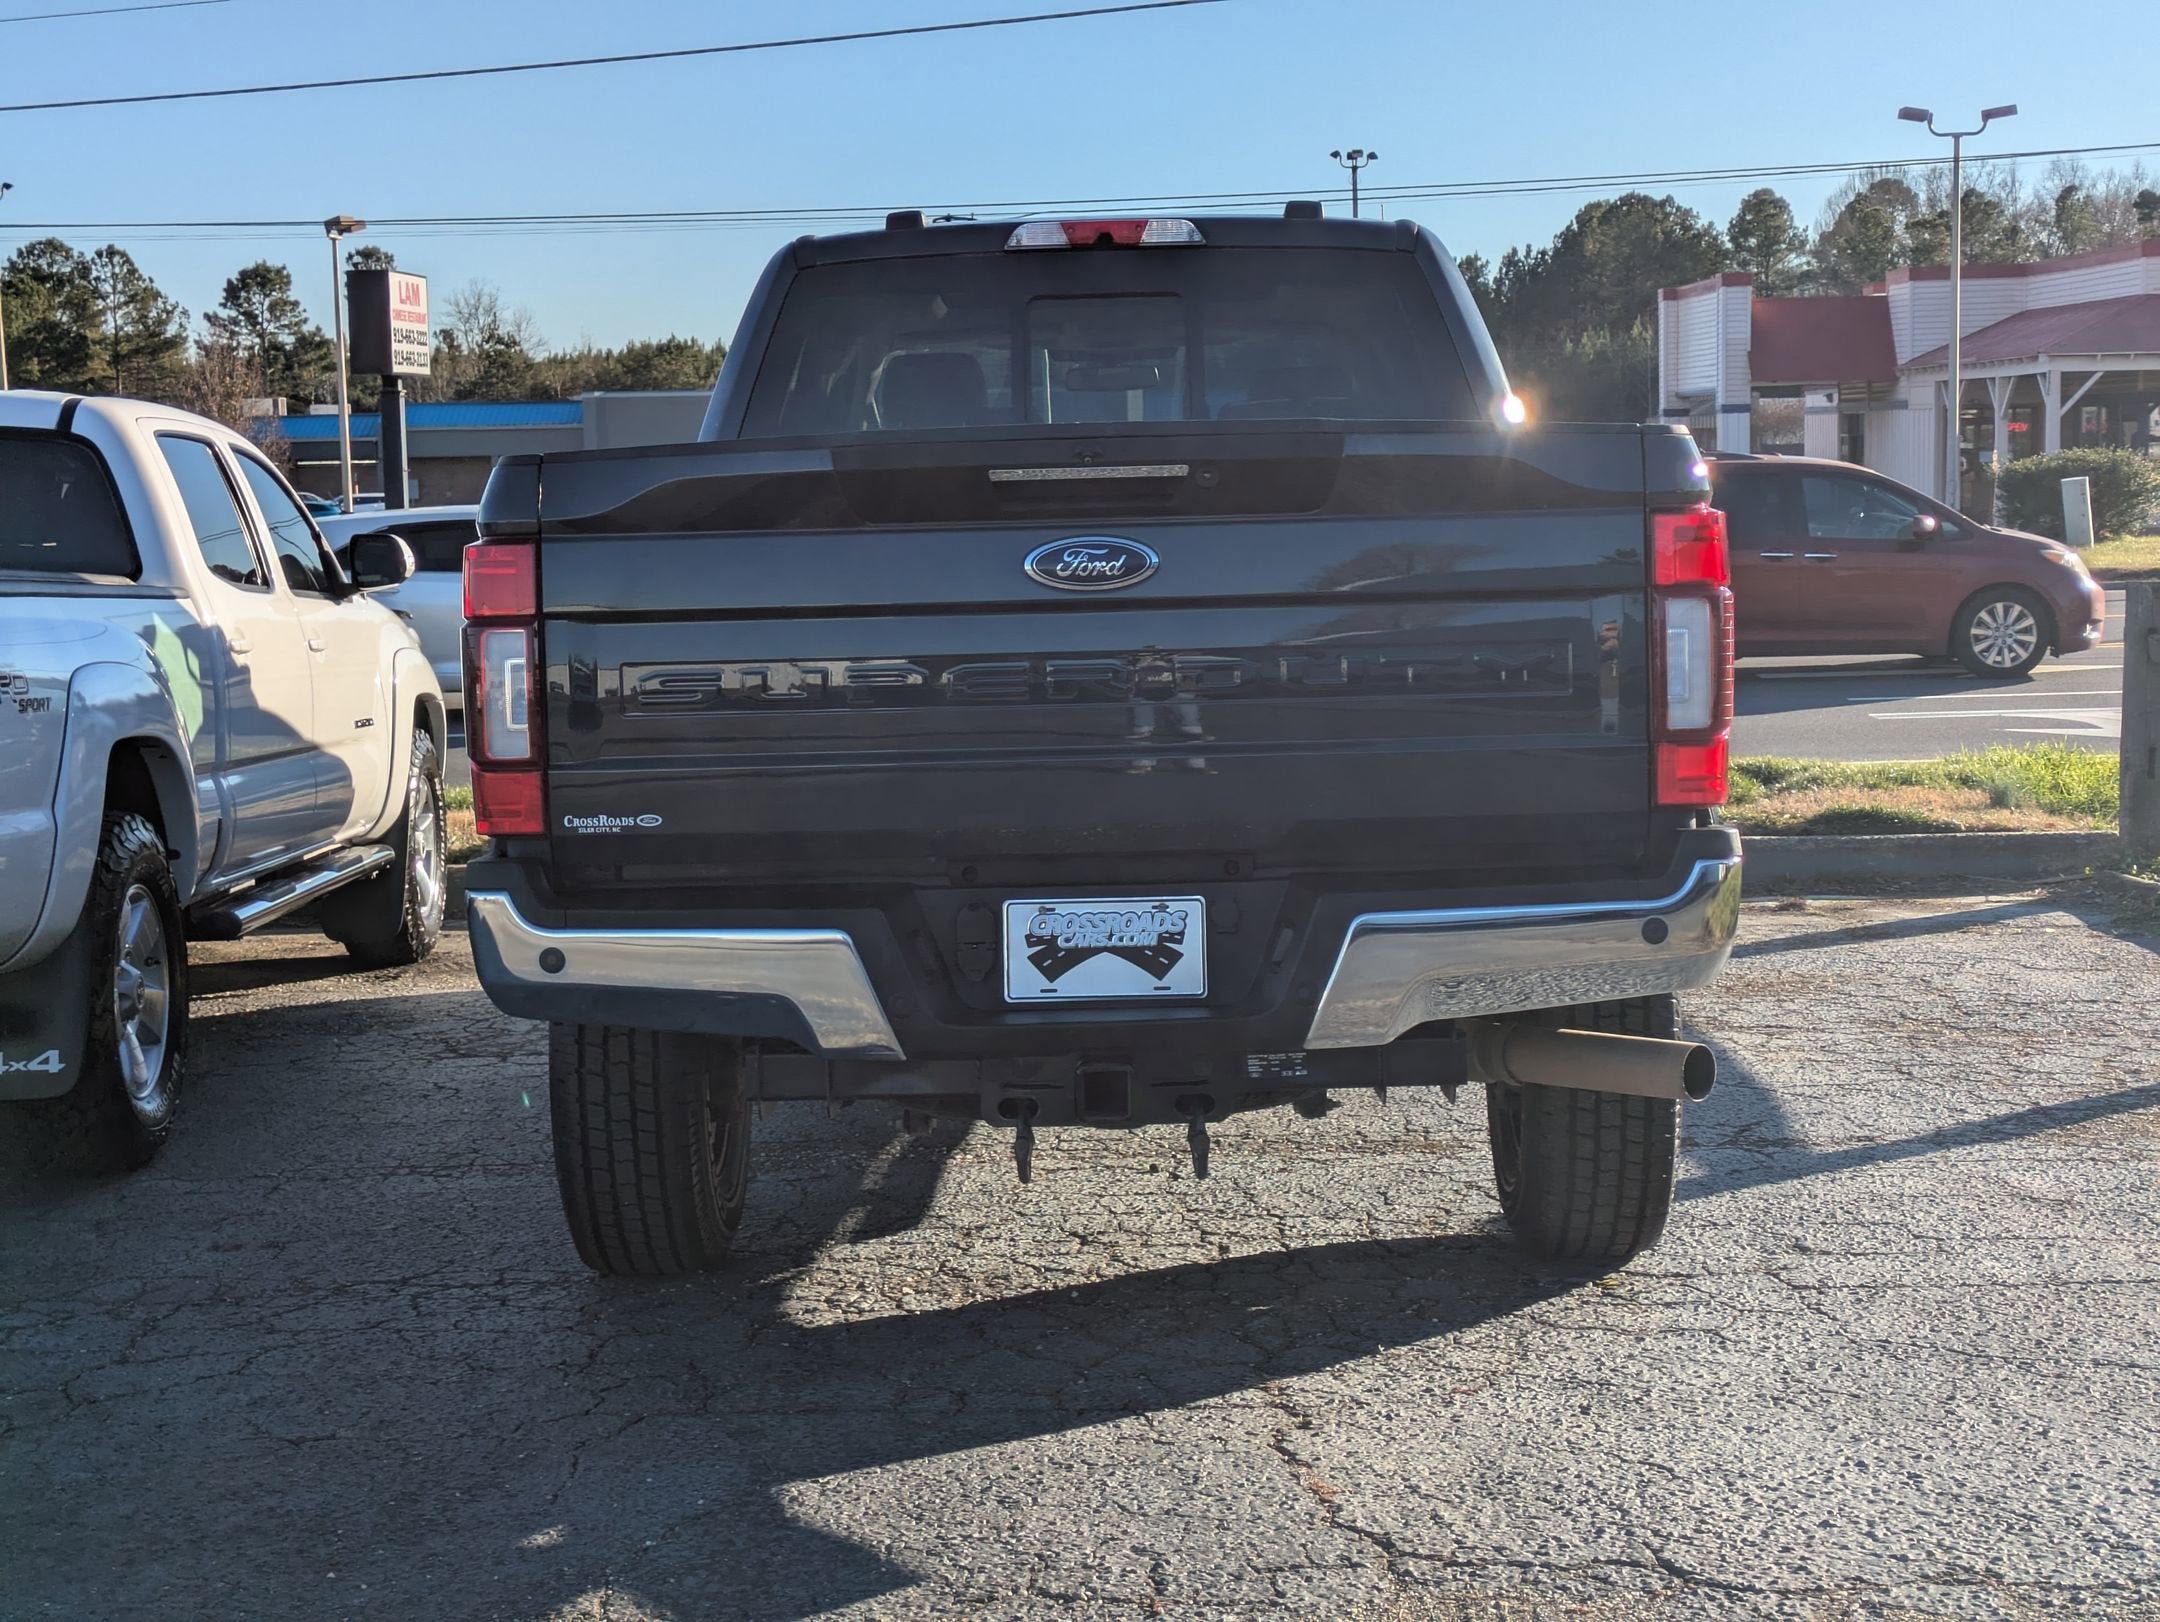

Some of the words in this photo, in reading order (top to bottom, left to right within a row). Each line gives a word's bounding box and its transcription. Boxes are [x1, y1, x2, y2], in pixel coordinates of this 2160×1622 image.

[399, 280, 420, 306] LAM
[1056, 548, 1127, 577] Ford
[637, 658, 1130, 706] SUPER
[18, 697, 52, 714] SPORT
[1029, 910, 1188, 936] CROSSROADS
[1057, 931, 1160, 950] CARS.COM
[0, 1049, 67, 1074] x4
